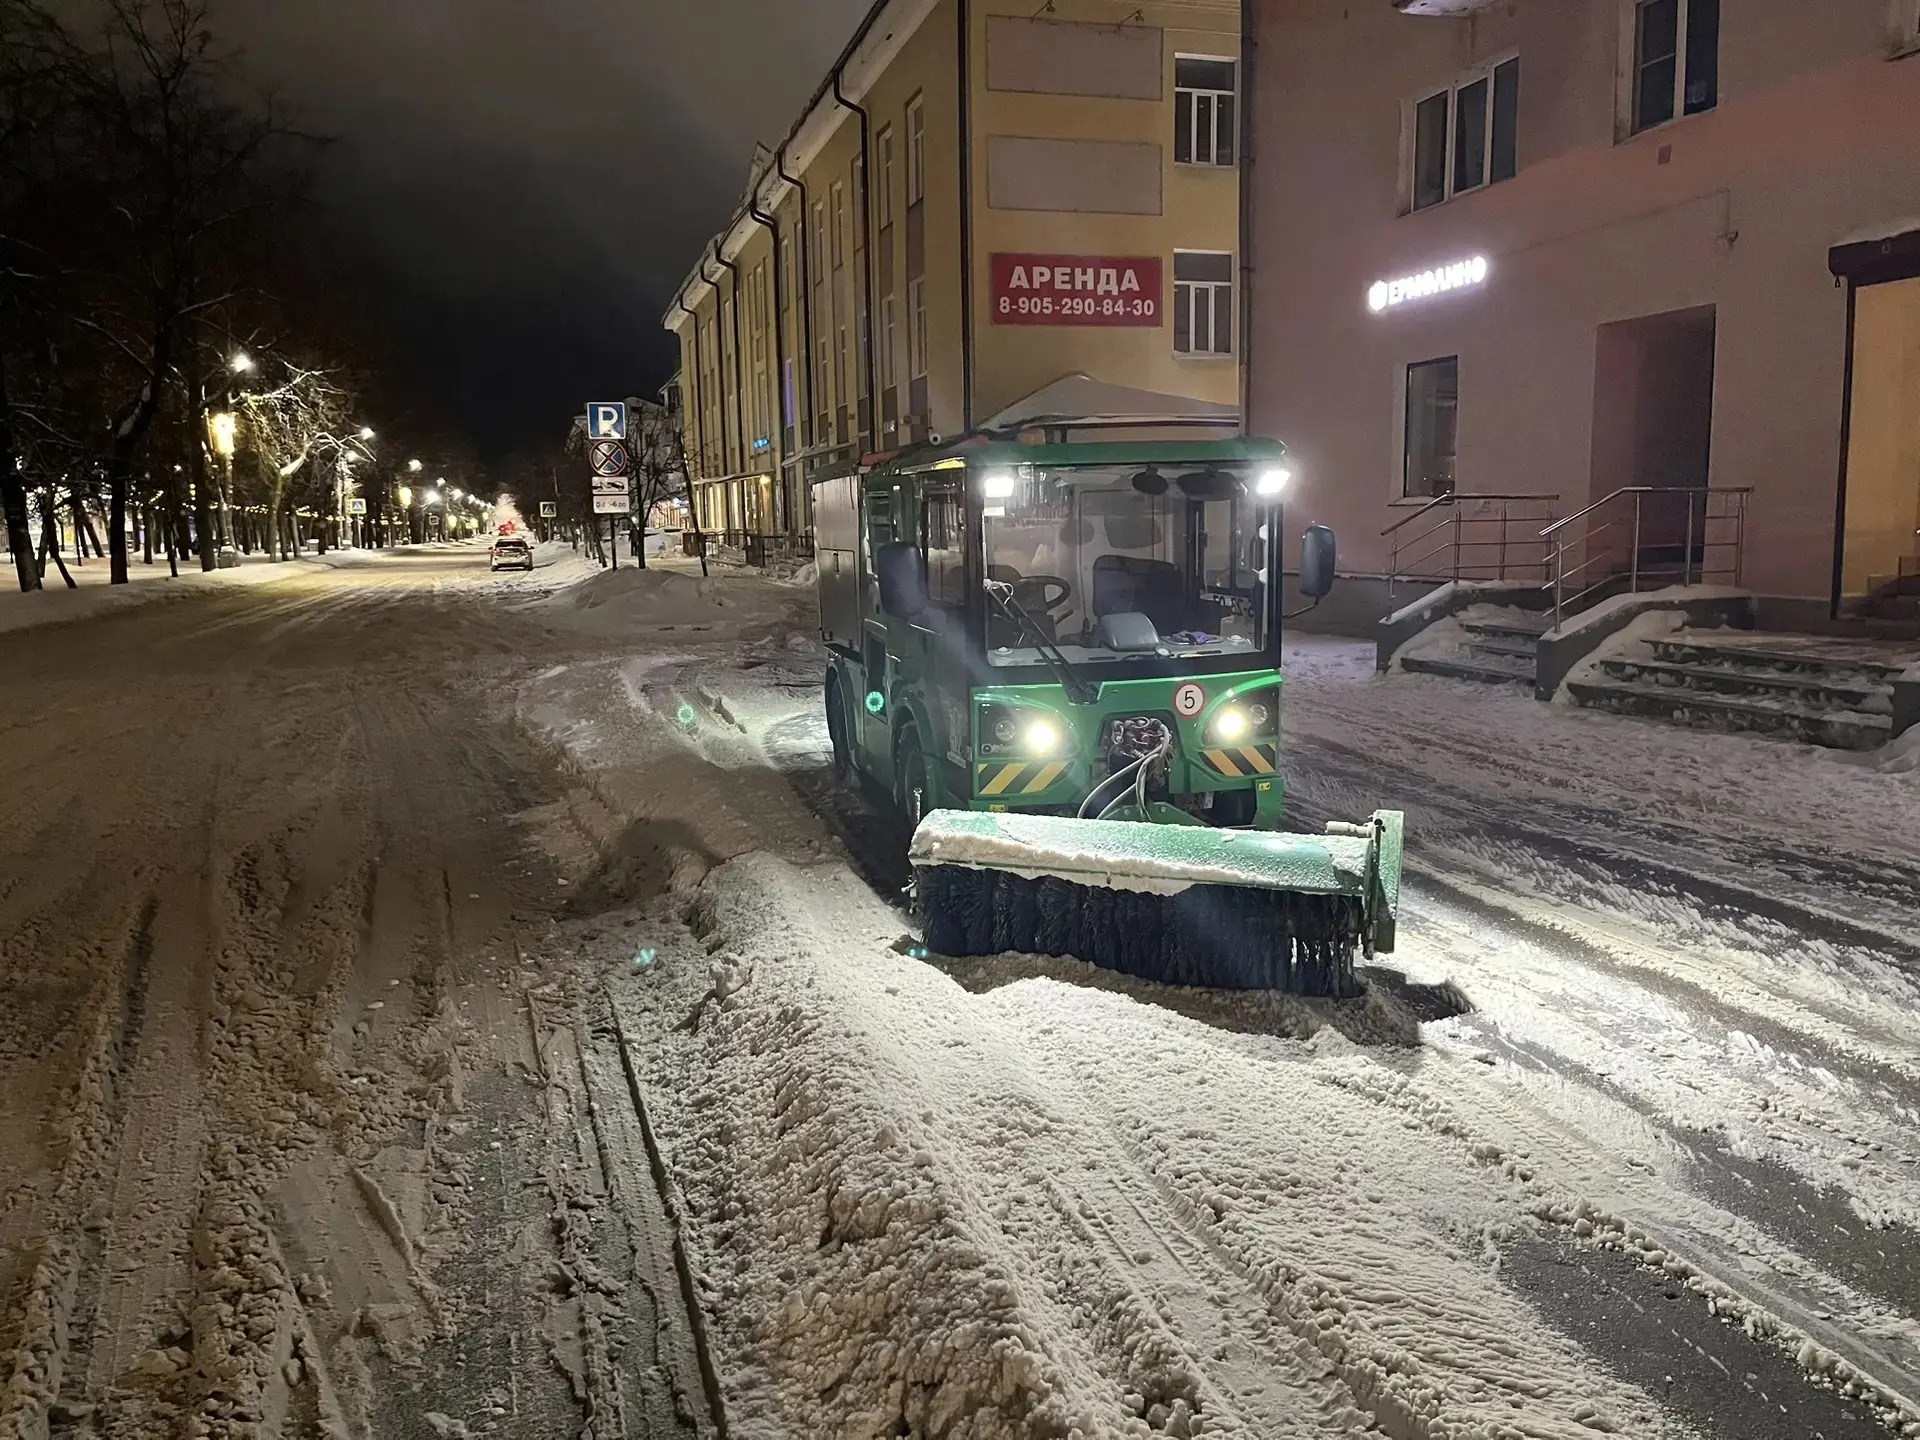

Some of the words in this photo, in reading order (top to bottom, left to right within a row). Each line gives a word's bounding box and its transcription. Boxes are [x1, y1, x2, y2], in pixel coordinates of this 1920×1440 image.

[1009, 266, 1140, 296] АРЕНДА
[999, 296, 1155, 316] 8-905-290-84-30
[1184, 690, 1196, 709] 5
